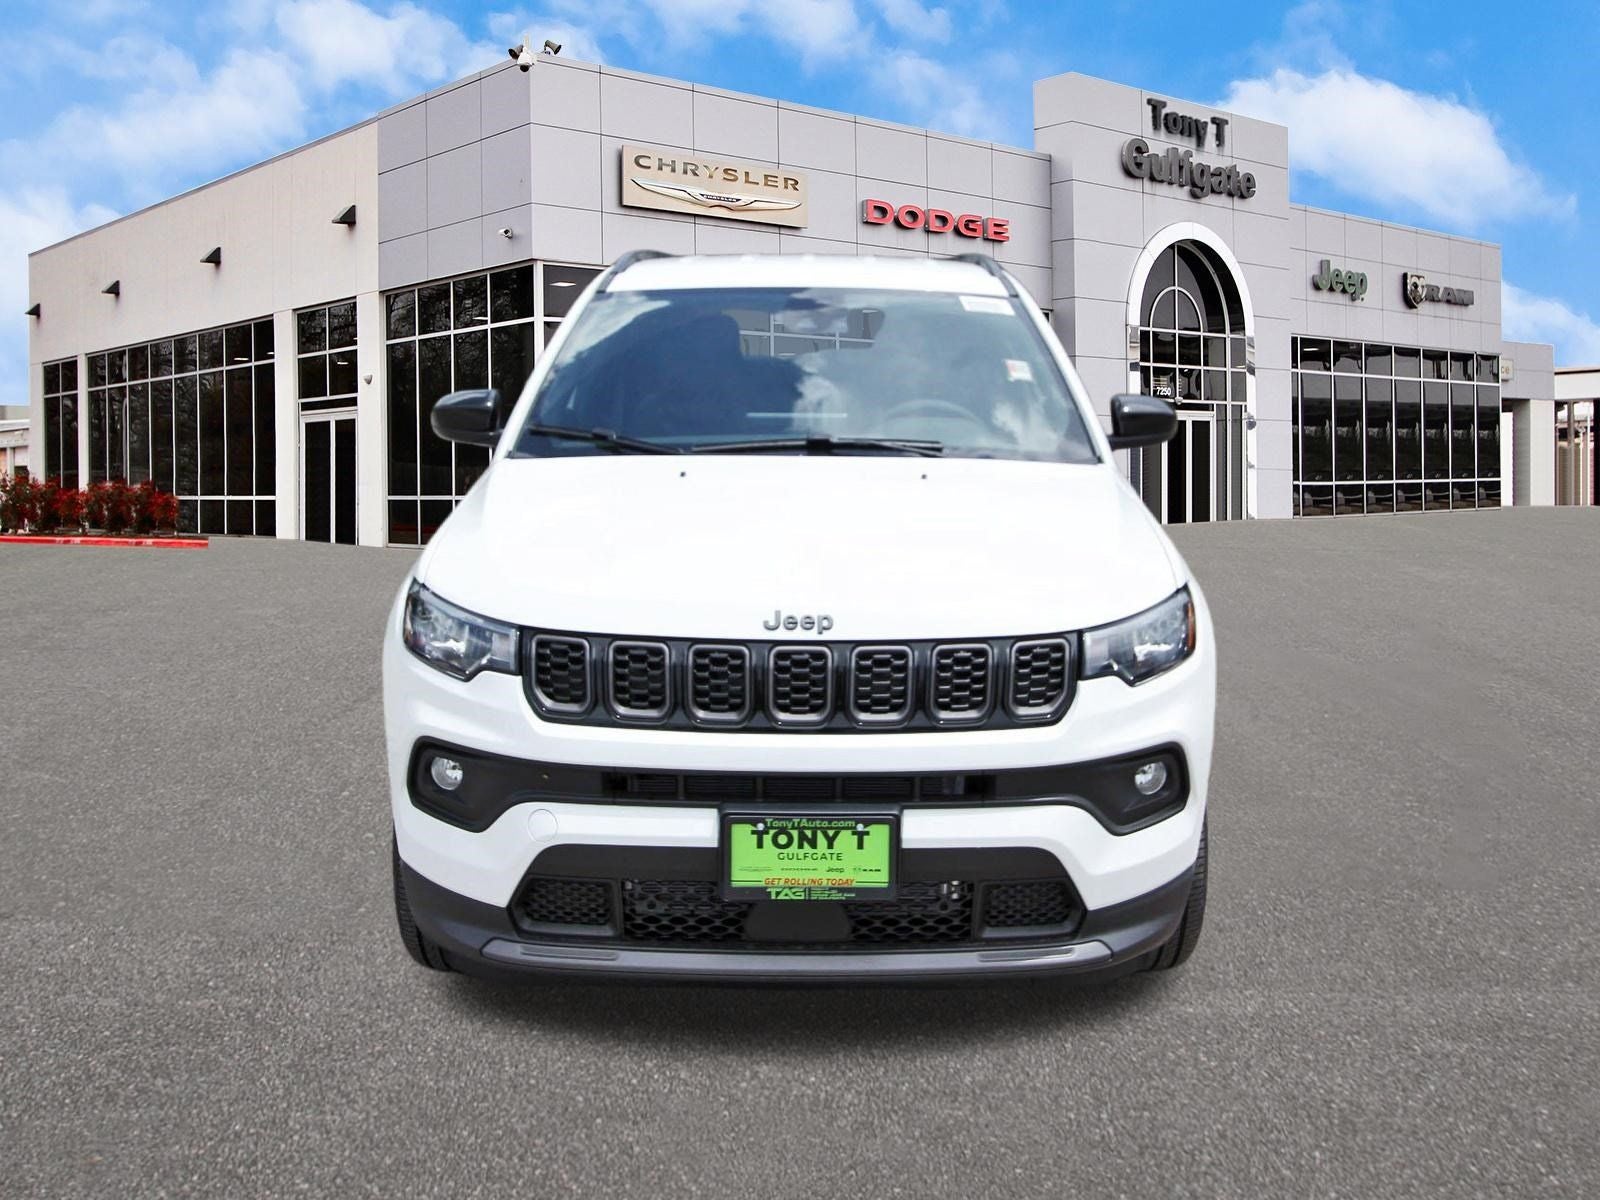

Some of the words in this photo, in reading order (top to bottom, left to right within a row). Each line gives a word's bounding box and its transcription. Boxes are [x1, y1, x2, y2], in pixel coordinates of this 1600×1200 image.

[1147, 98, 1208, 147] Tony
[1211, 116, 1229, 147] T
[634, 154, 800, 191] CHRYSLER
[1122, 138, 1256, 199] Gulfgate
[863, 199, 1010, 242] DODGE
[1312, 259, 1368, 302] Jeep
[1425, 284, 1475, 307] RAM
[1156, 387, 1171, 396] 7250
[763, 610, 834, 635] Jeep
[765, 818, 856, 828] TonyTAuto.com
[751, 829, 841, 850] TONY
[851, 831, 870, 850] T
[777, 852, 844, 861] GULFGATE
[764, 877, 783, 886] GET
[783, 877, 824, 886] ROLLING
[825, 878, 855, 886] TODAY
[766, 887, 805, 900] TAG
